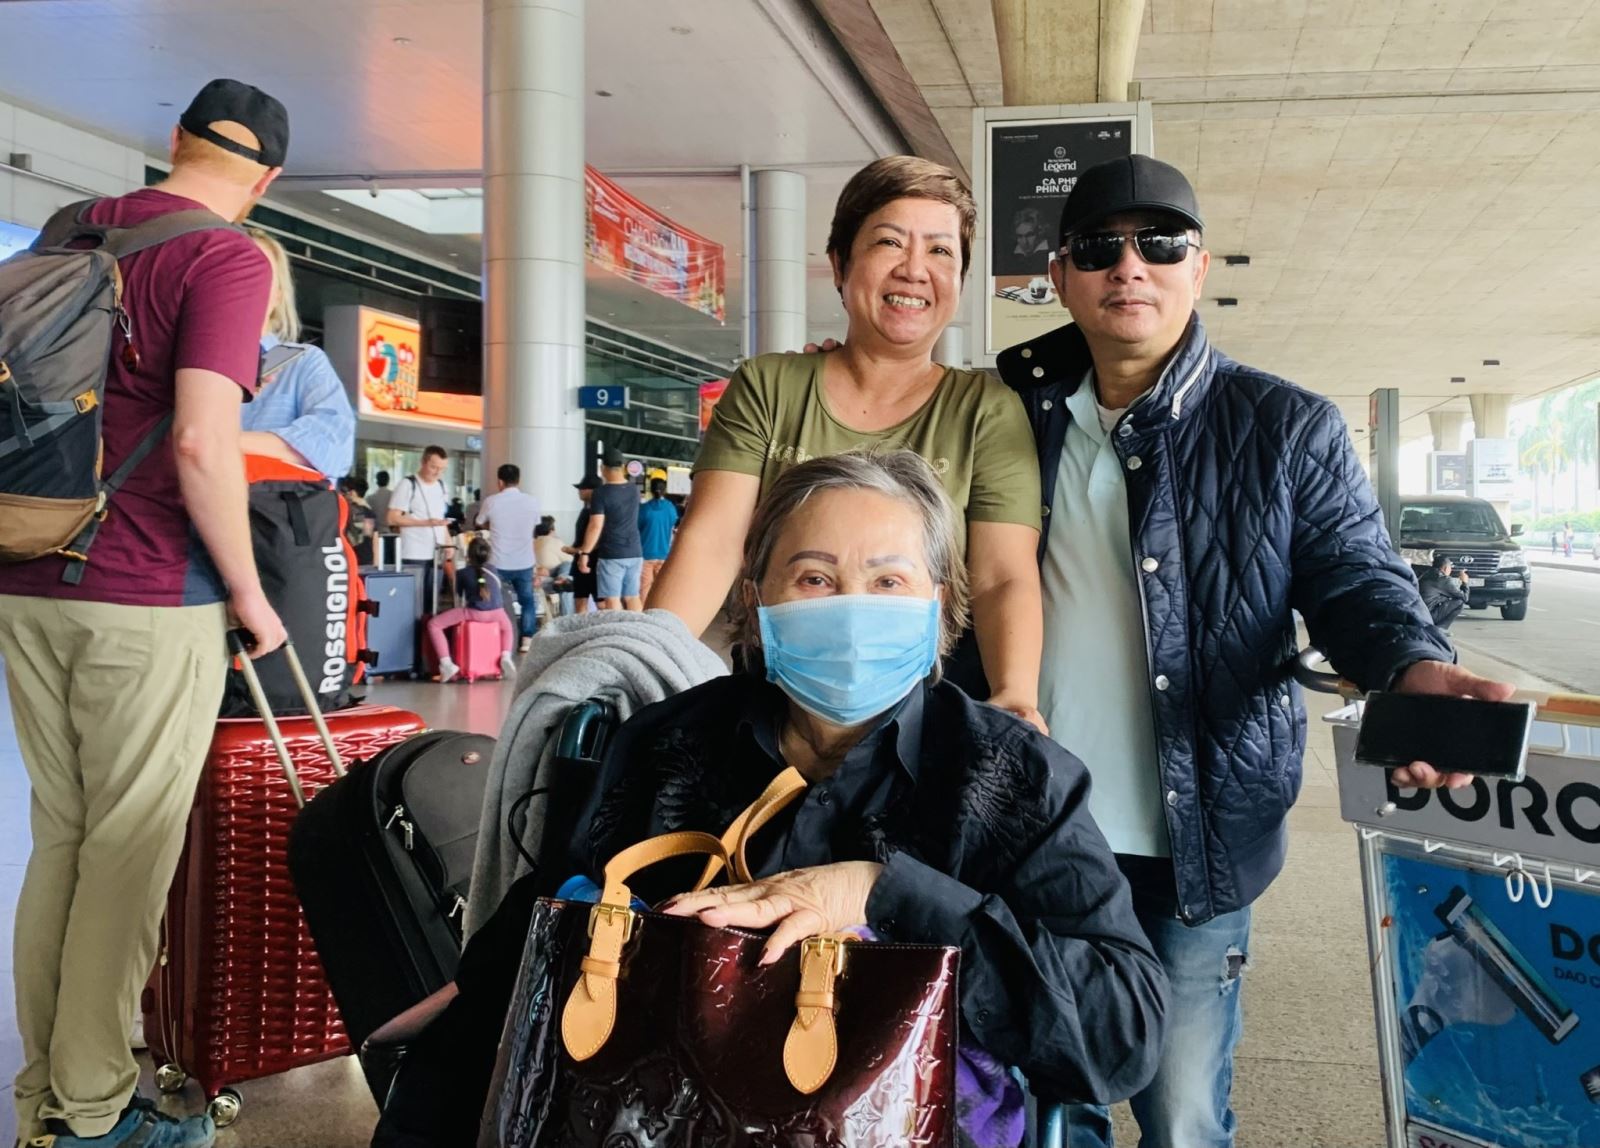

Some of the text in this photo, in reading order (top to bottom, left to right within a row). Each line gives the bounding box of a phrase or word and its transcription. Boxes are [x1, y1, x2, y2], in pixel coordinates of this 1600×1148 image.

[1043, 160, 1077, 173] Legend
[1036, 184, 1074, 194] PHIN GI
[597, 389, 609, 405] 9
[319, 537, 348, 694] ROSSIGNOL
